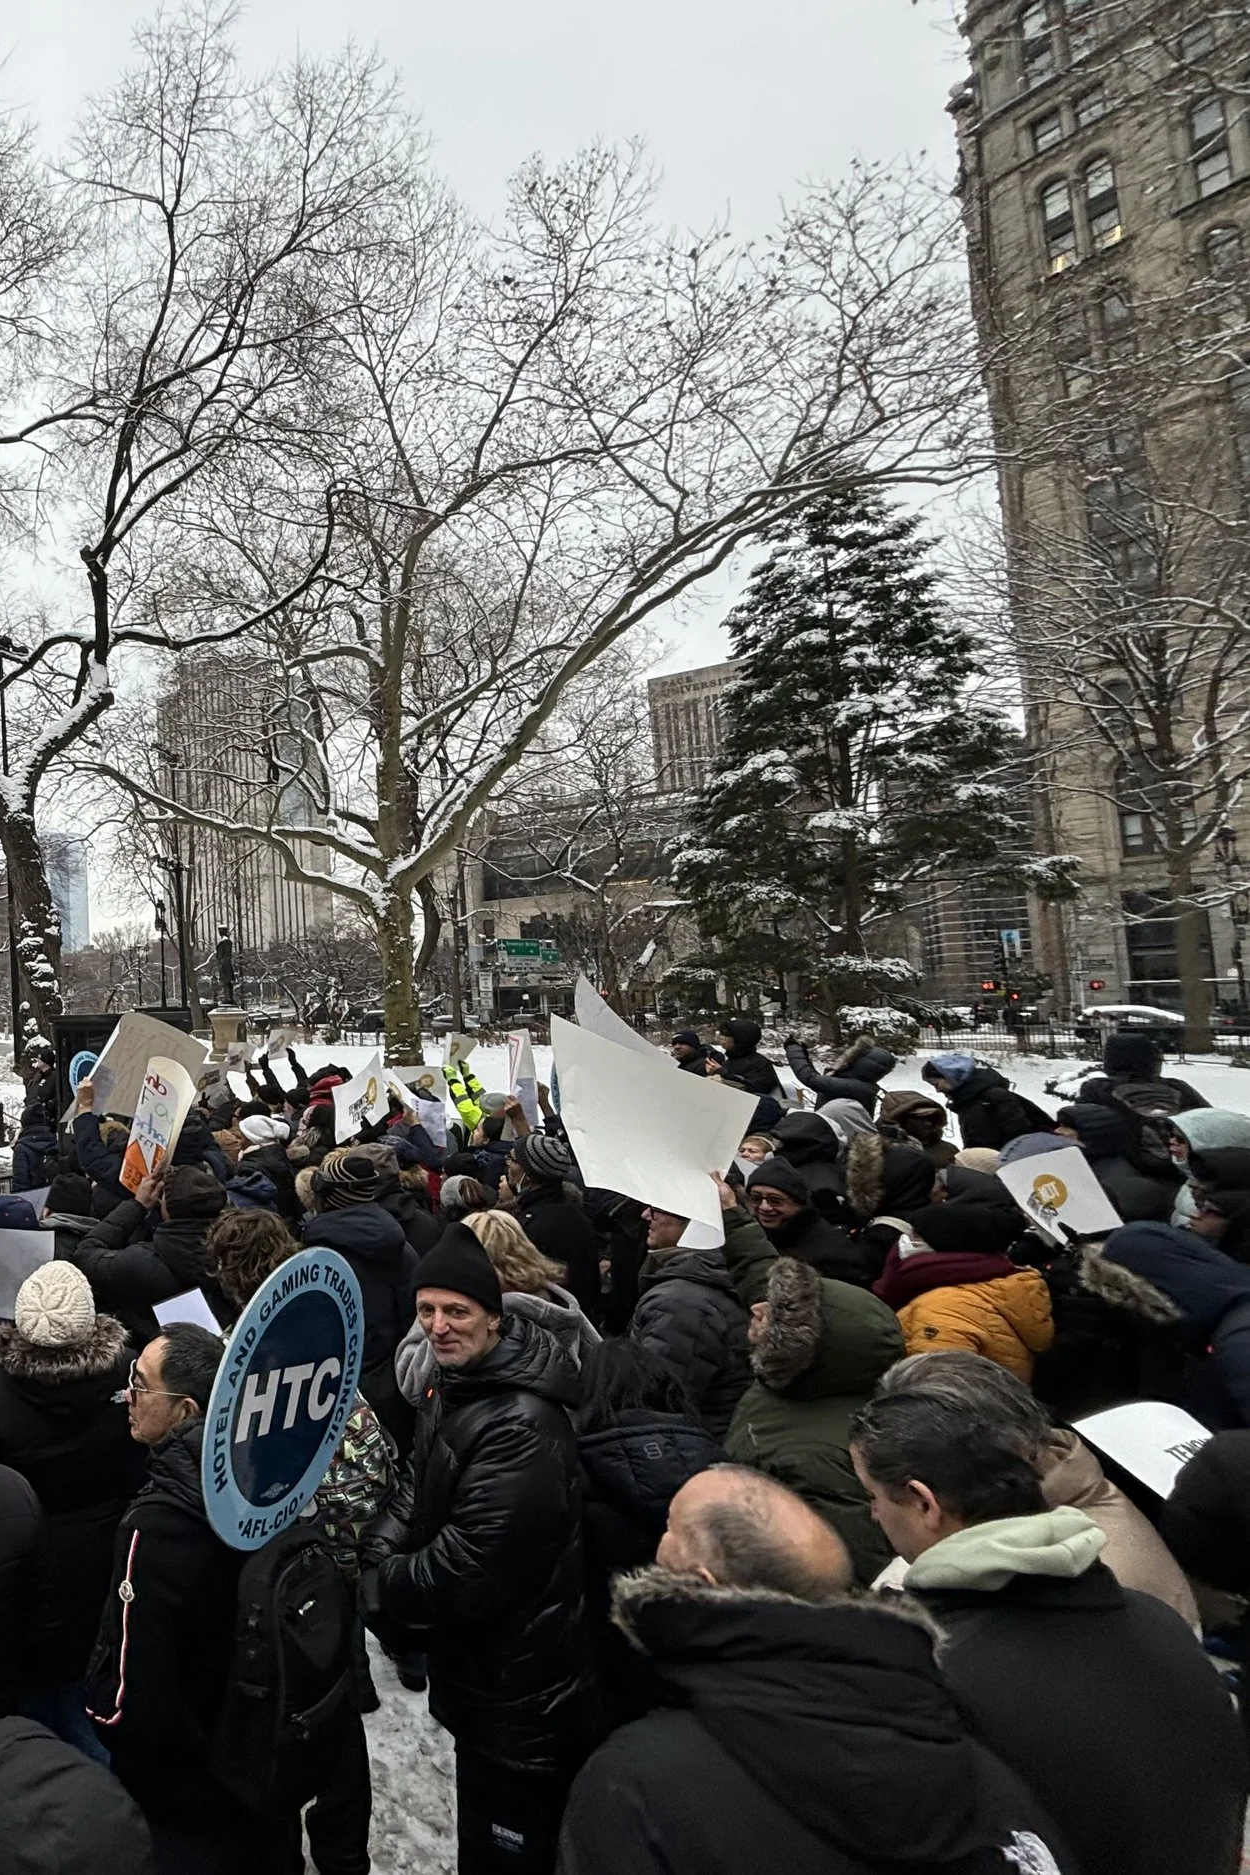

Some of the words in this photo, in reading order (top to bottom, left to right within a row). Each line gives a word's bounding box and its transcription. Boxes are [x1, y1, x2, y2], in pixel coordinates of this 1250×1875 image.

[259, 1263, 320, 1322] GAMING
[323, 1265, 358, 1330] TRADES
[228, 1326, 257, 1388] AND
[324, 1333, 358, 1445] COUNCIL
[234, 1357, 342, 1444] HTC
[213, 1397, 233, 1494] HOTEL
